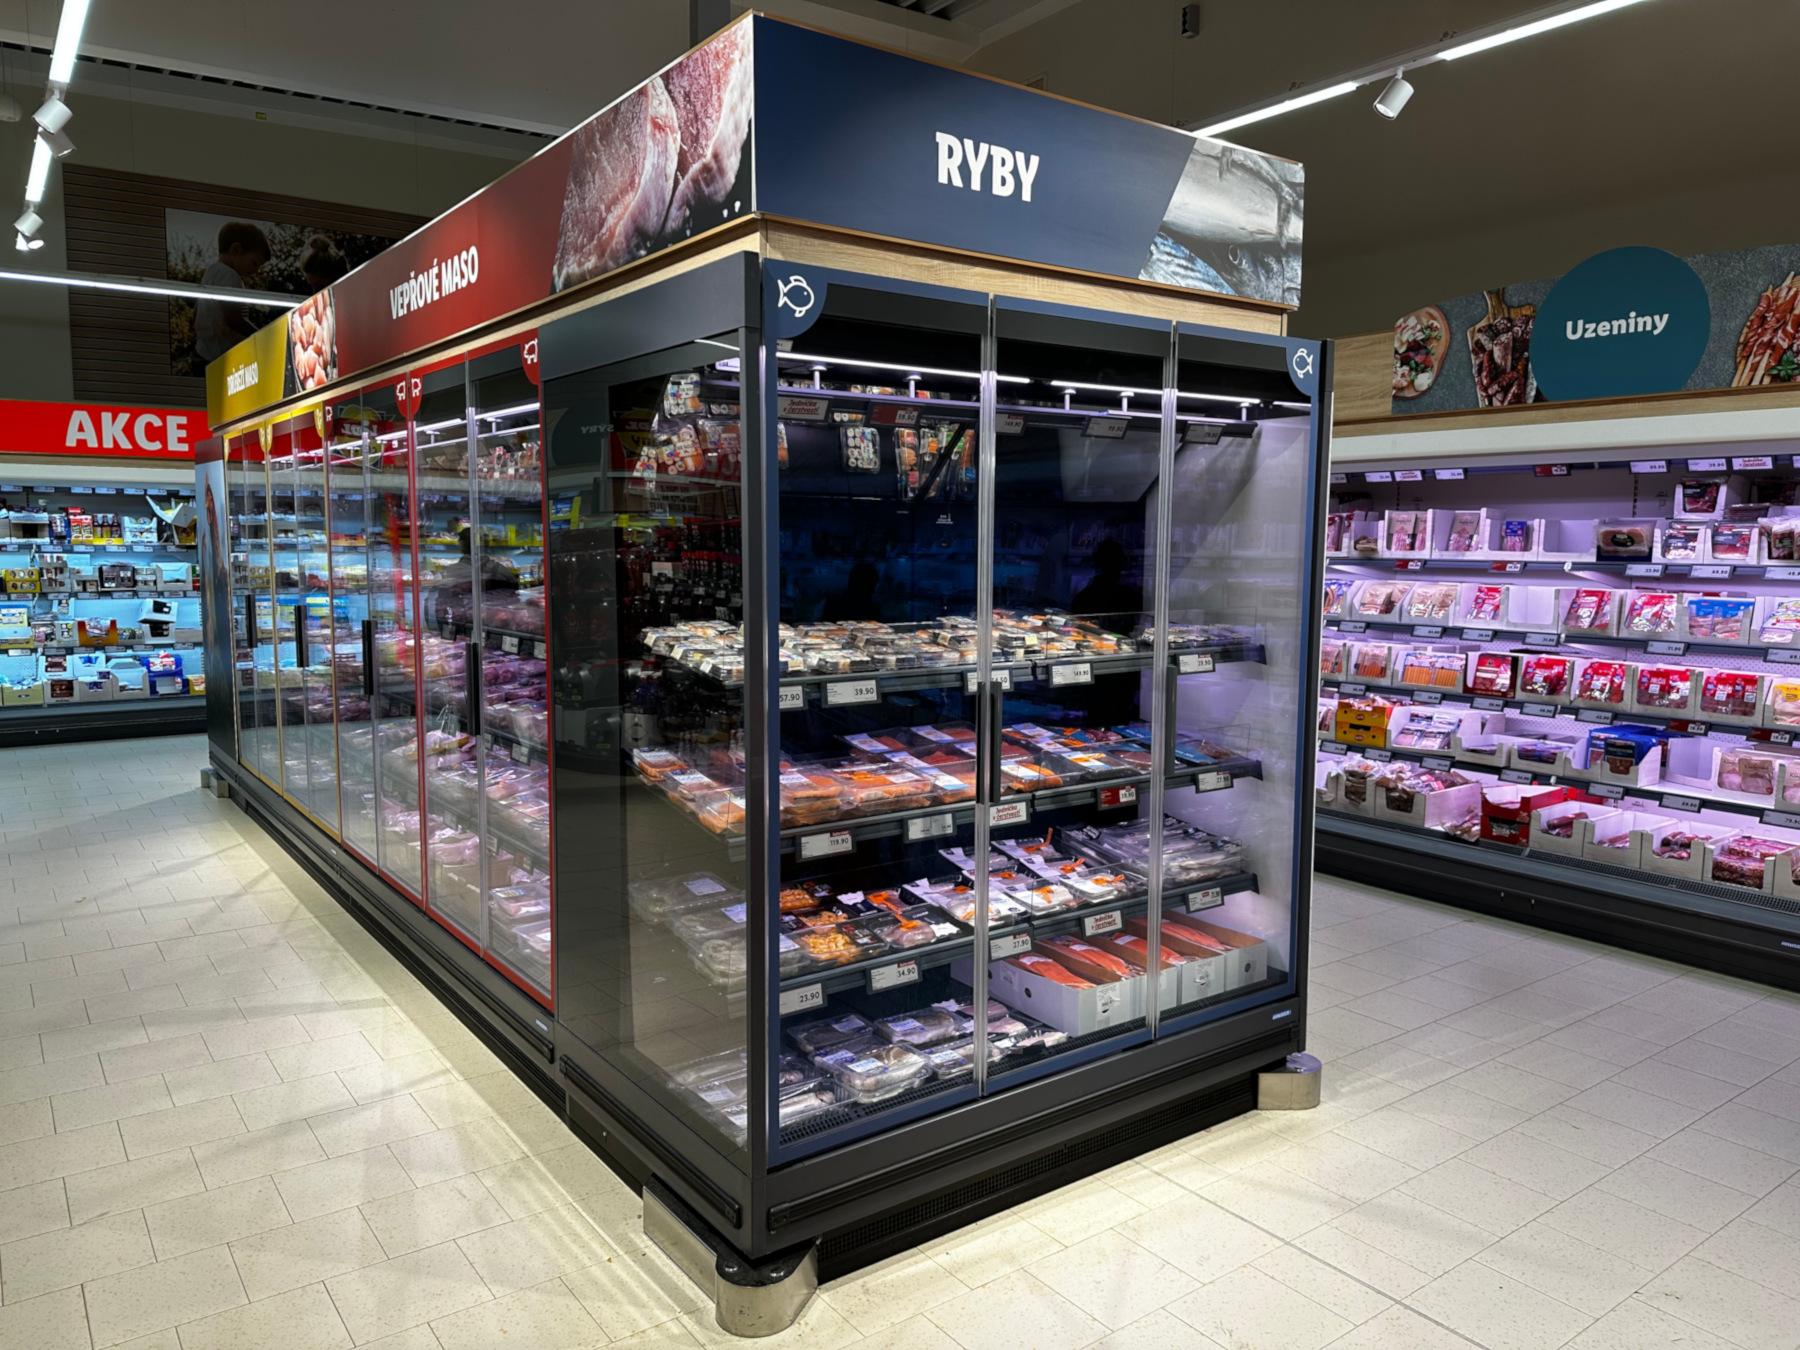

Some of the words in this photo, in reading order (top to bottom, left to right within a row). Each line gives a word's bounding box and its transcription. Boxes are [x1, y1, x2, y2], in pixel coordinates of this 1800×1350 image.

[935, 131, 1040, 203] RYBY
[390, 258, 440, 320] VEPŘOVÉ
[441, 245, 479, 296] MASO
[1565, 311, 1670, 341] Uzeniny
[898, 413, 916, 422] 59.90
[66, 409, 190, 452] AKCE
[779, 692, 800, 702] 57.90
[854, 688, 874, 696] 39.90
[1012, 939, 1029, 949] 27.90
[896, 967, 916, 978] 34.90
[799, 991, 820, 1002] 23.90
